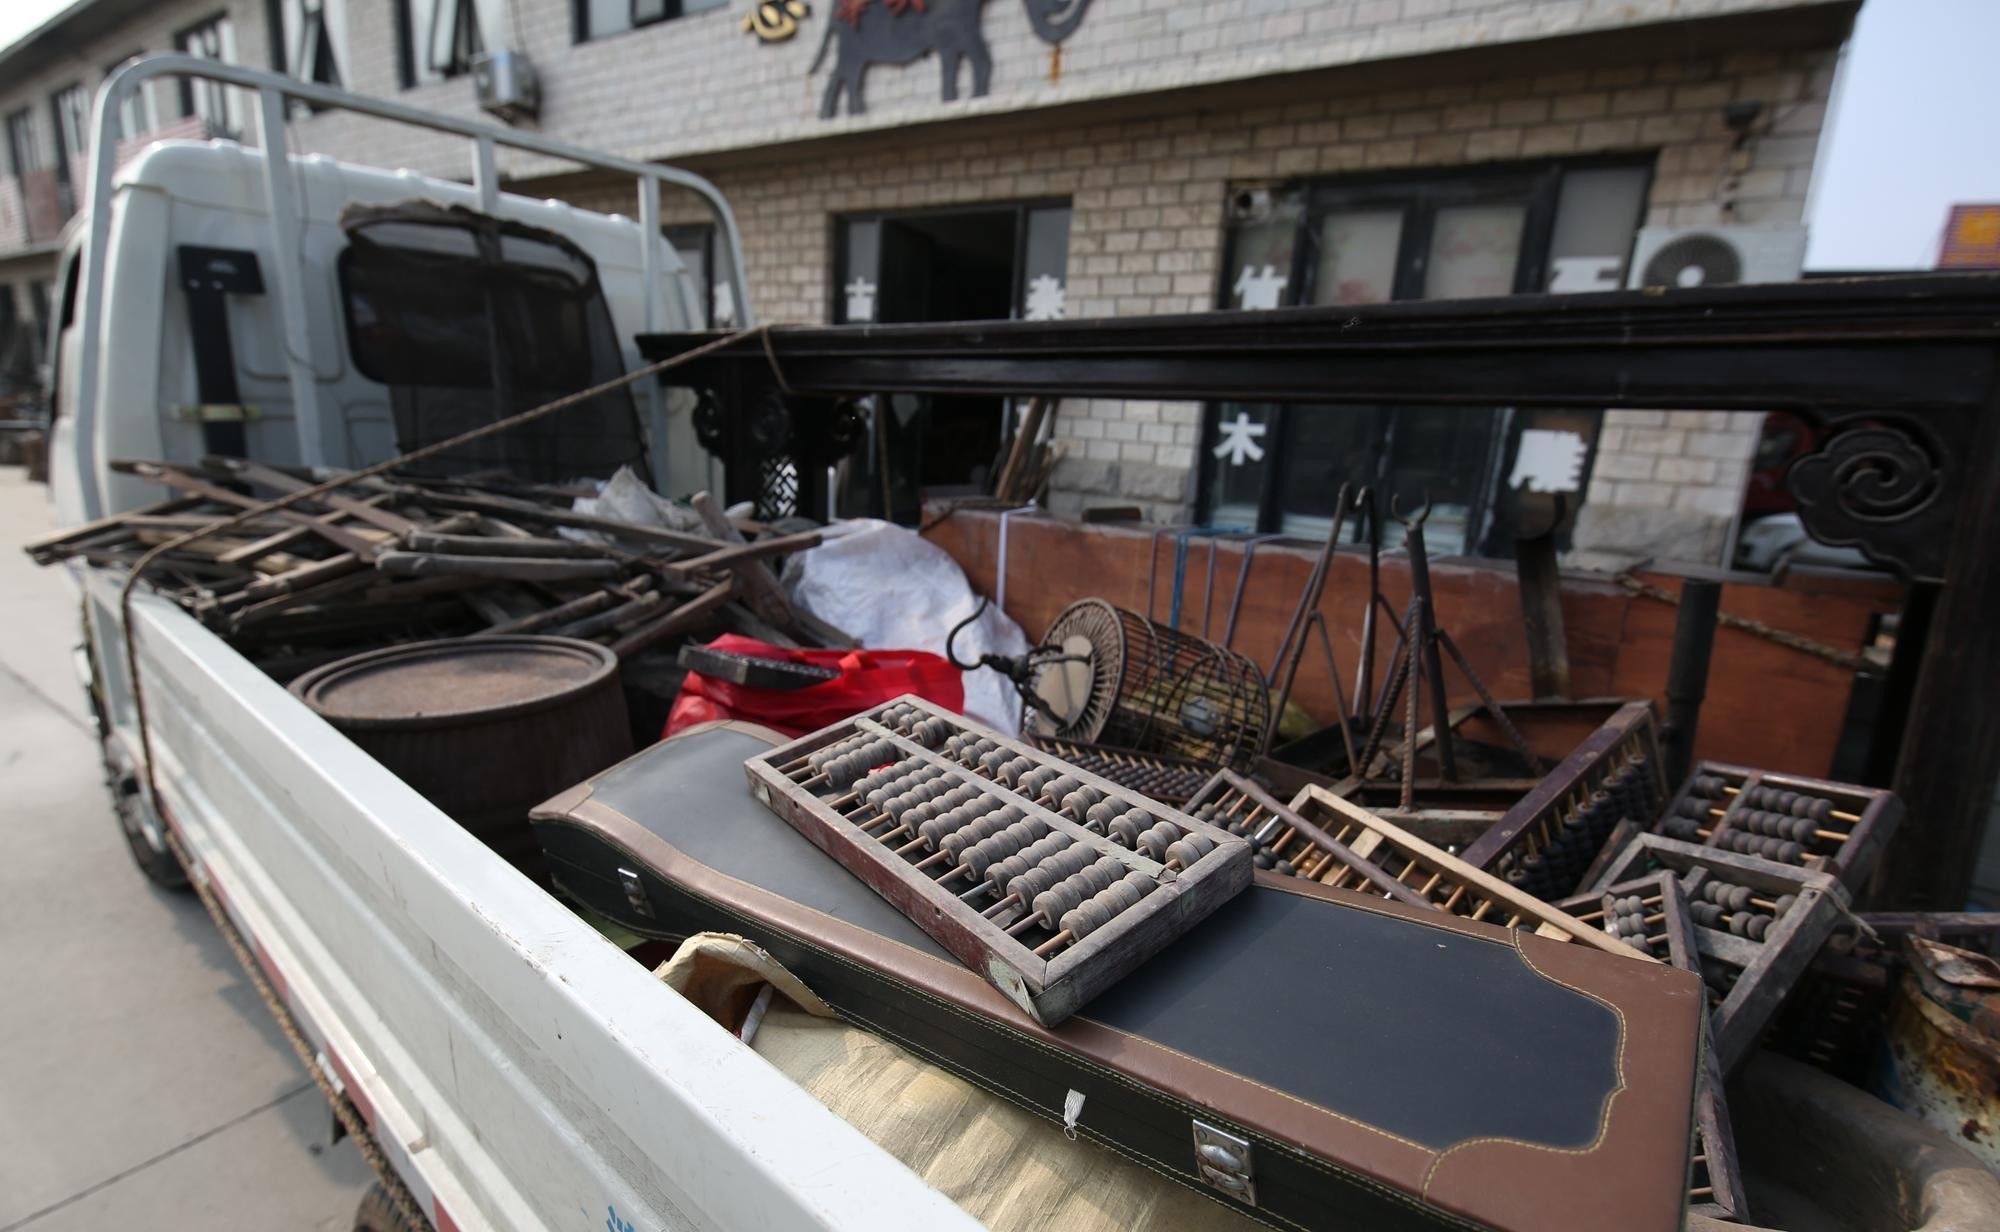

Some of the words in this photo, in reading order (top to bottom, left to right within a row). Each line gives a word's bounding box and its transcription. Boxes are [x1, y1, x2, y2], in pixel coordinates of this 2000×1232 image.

[845, 276, 877, 321] 古
[1233, 263, 1288, 311] 竹
[1213, 412, 1266, 466] 木
